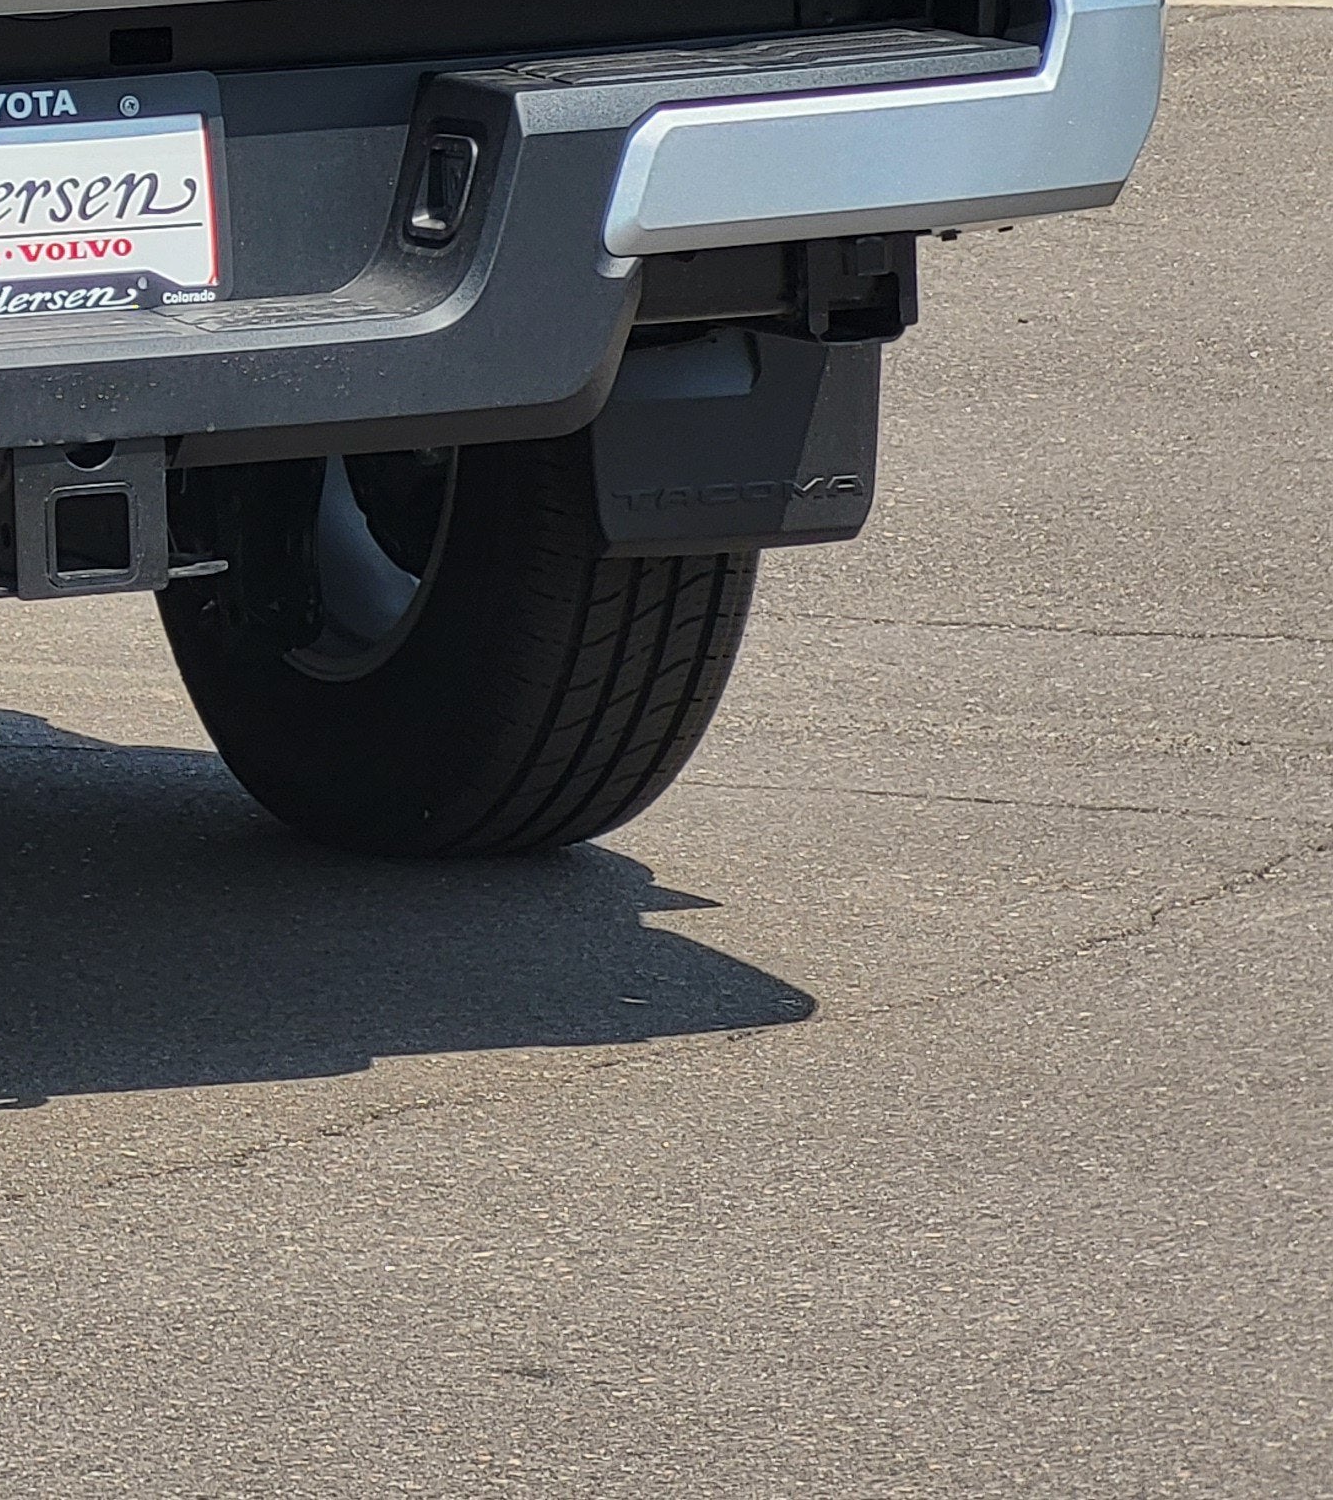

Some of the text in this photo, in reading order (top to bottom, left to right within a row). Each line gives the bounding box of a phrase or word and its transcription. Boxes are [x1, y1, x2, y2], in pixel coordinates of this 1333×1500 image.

[16, 238, 133, 263] VOLVO
[162, 289, 216, 305] Colorado
[612, 474, 865, 511] TACOMA
